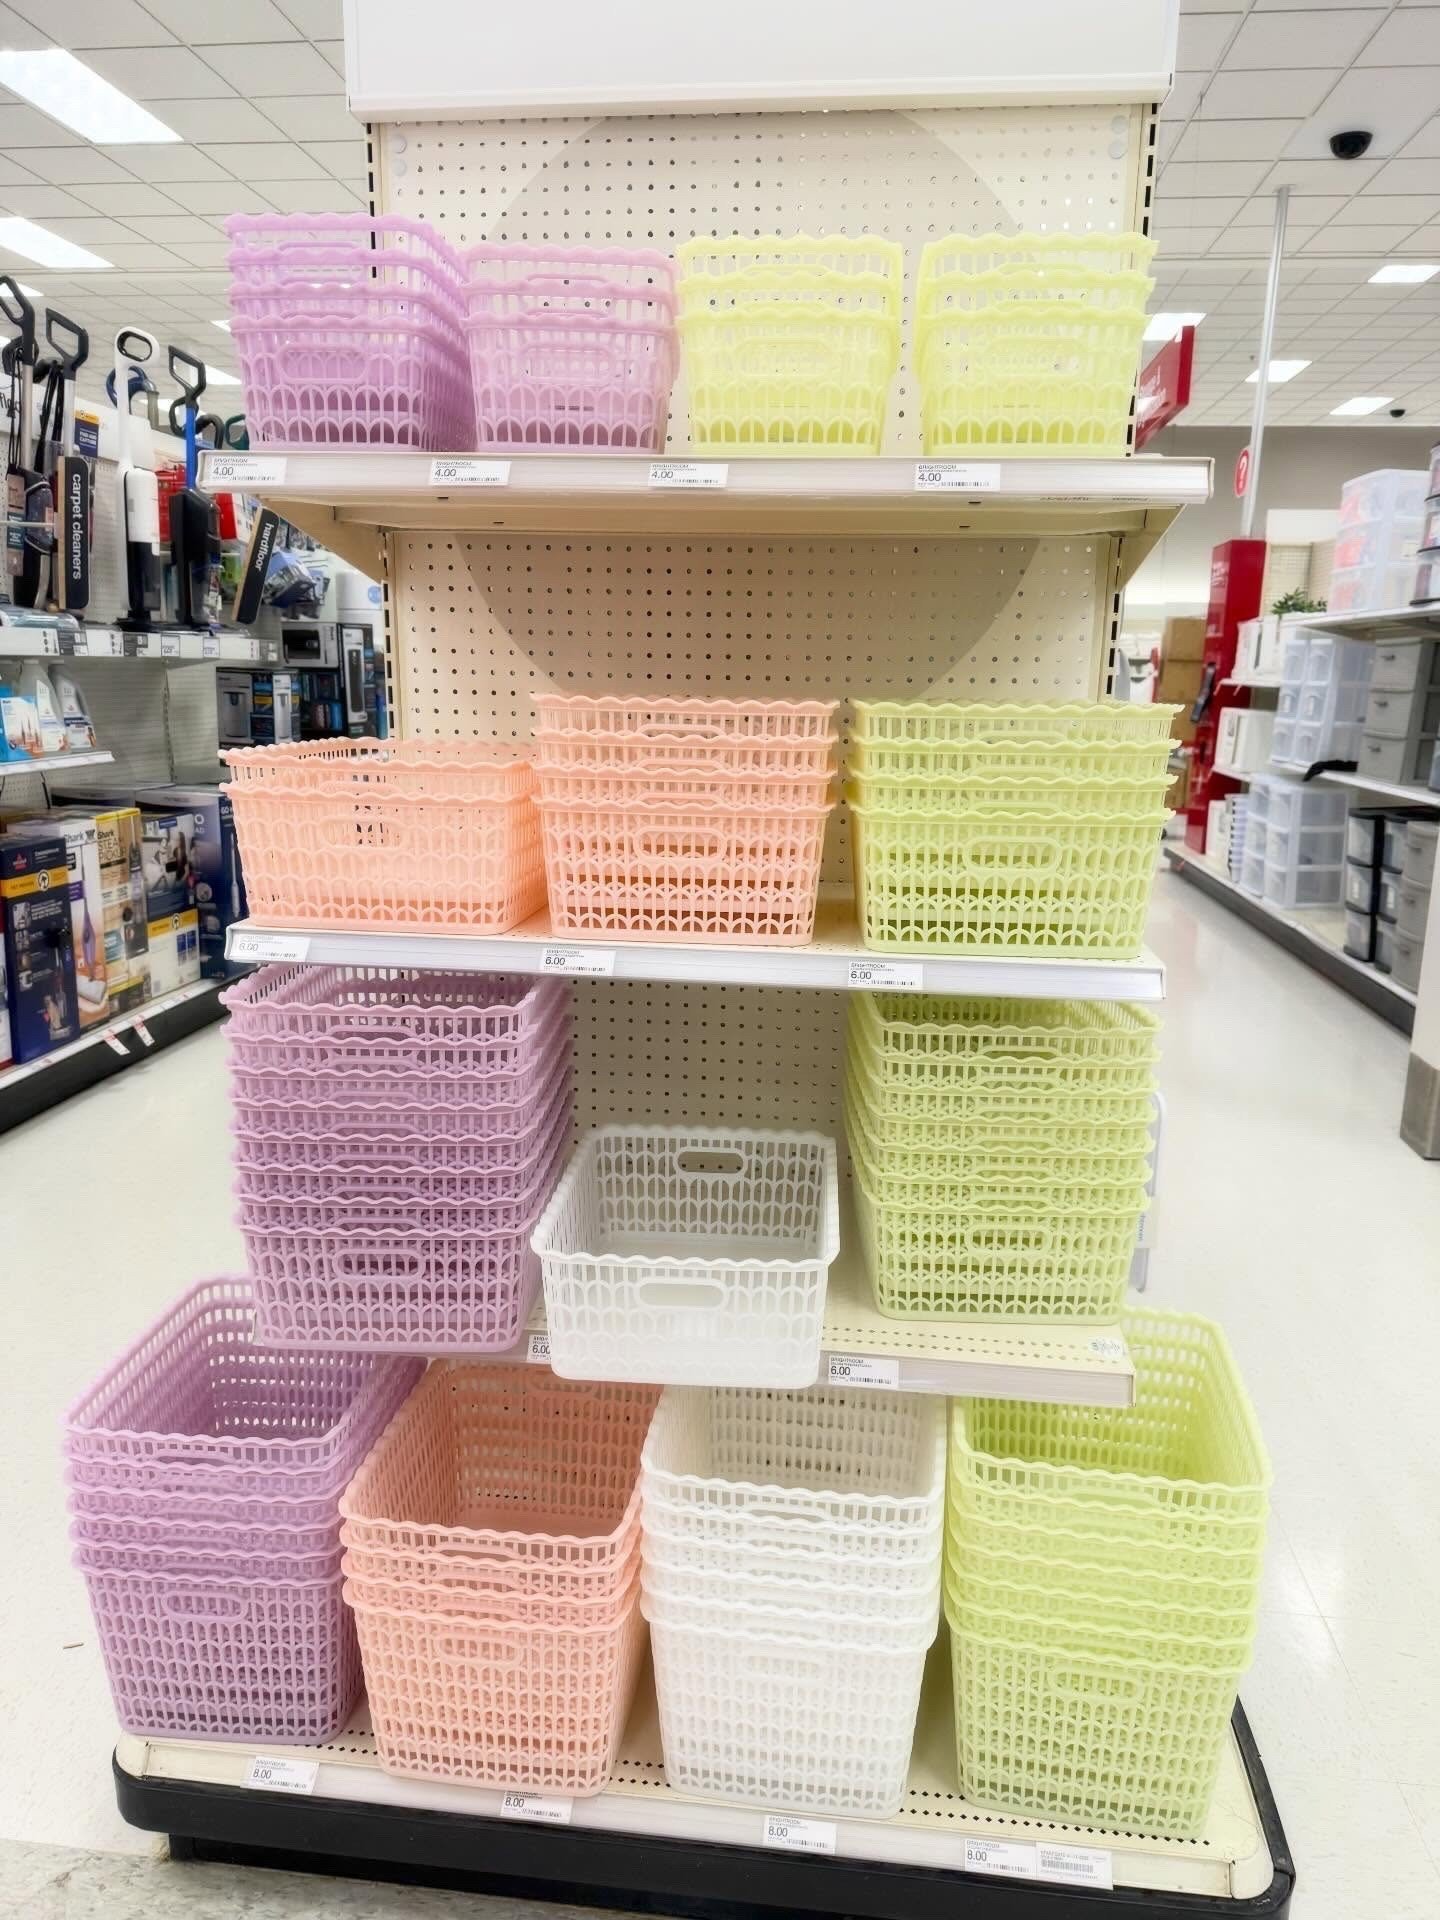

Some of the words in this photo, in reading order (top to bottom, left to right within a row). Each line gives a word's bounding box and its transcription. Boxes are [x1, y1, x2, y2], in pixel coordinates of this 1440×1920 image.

[213, 466, 234, 476] 4.00
[434, 468, 457, 477] 4.00
[651, 470, 674, 479] 4.00
[918, 472, 942, 482] 4.00
[72, 473, 82, 518] carpet
[72, 522, 82, 580] cleaners
[255, 522, 275, 571] hardfloor
[545, 956, 566, 966] 6.00
[850, 970, 872, 980] 6.00
[830, 1365, 851, 1376] 6.00
[253, 1768, 272, 1780] 8.00
[505, 1796, 525, 1808] 8.00
[768, 1825, 788, 1838] 8.00
[967, 1848, 988, 1861] 8.00
